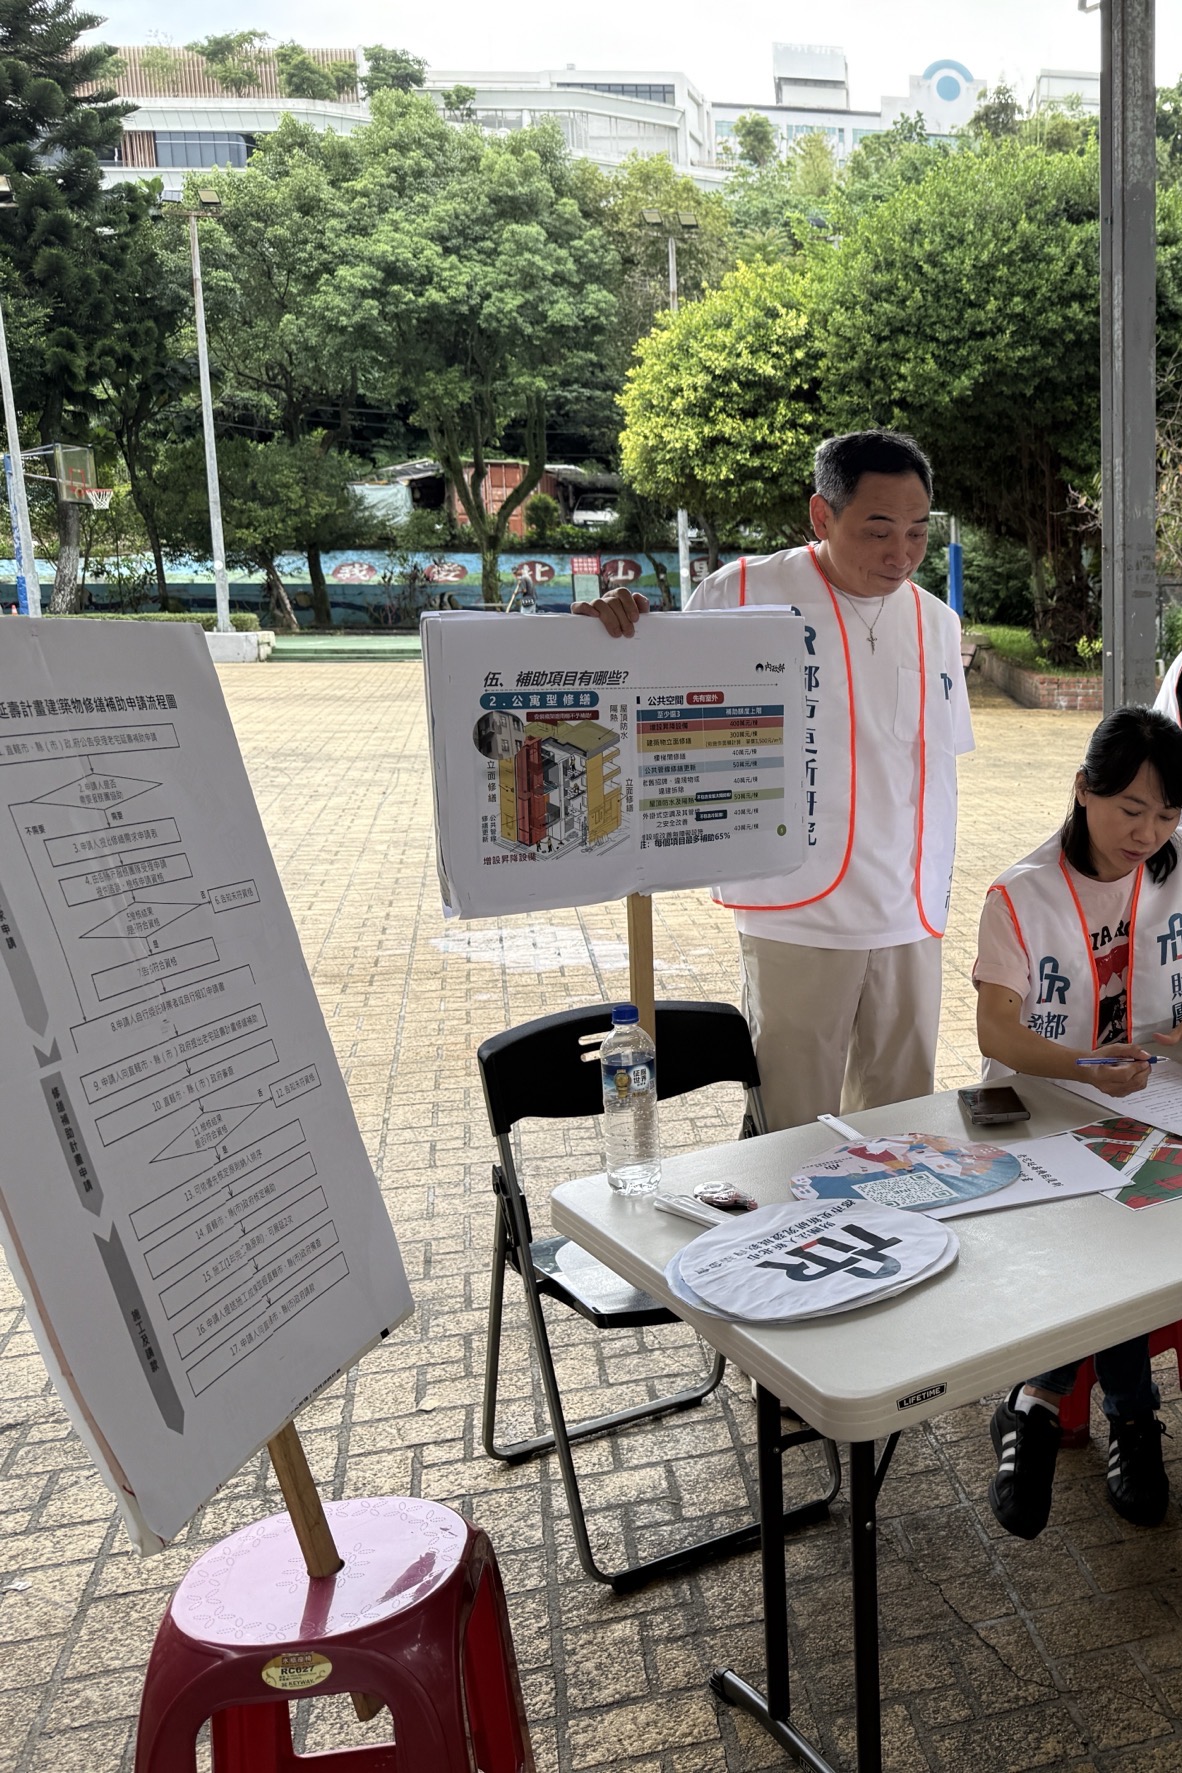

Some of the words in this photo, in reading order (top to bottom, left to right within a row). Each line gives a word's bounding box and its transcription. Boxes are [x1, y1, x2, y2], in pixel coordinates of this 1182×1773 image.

[647, 695, 684, 706] 公共空間
[620, 704, 628, 740] 屋頂防水
[903, 1387, 941, 1406] LIFETIME
